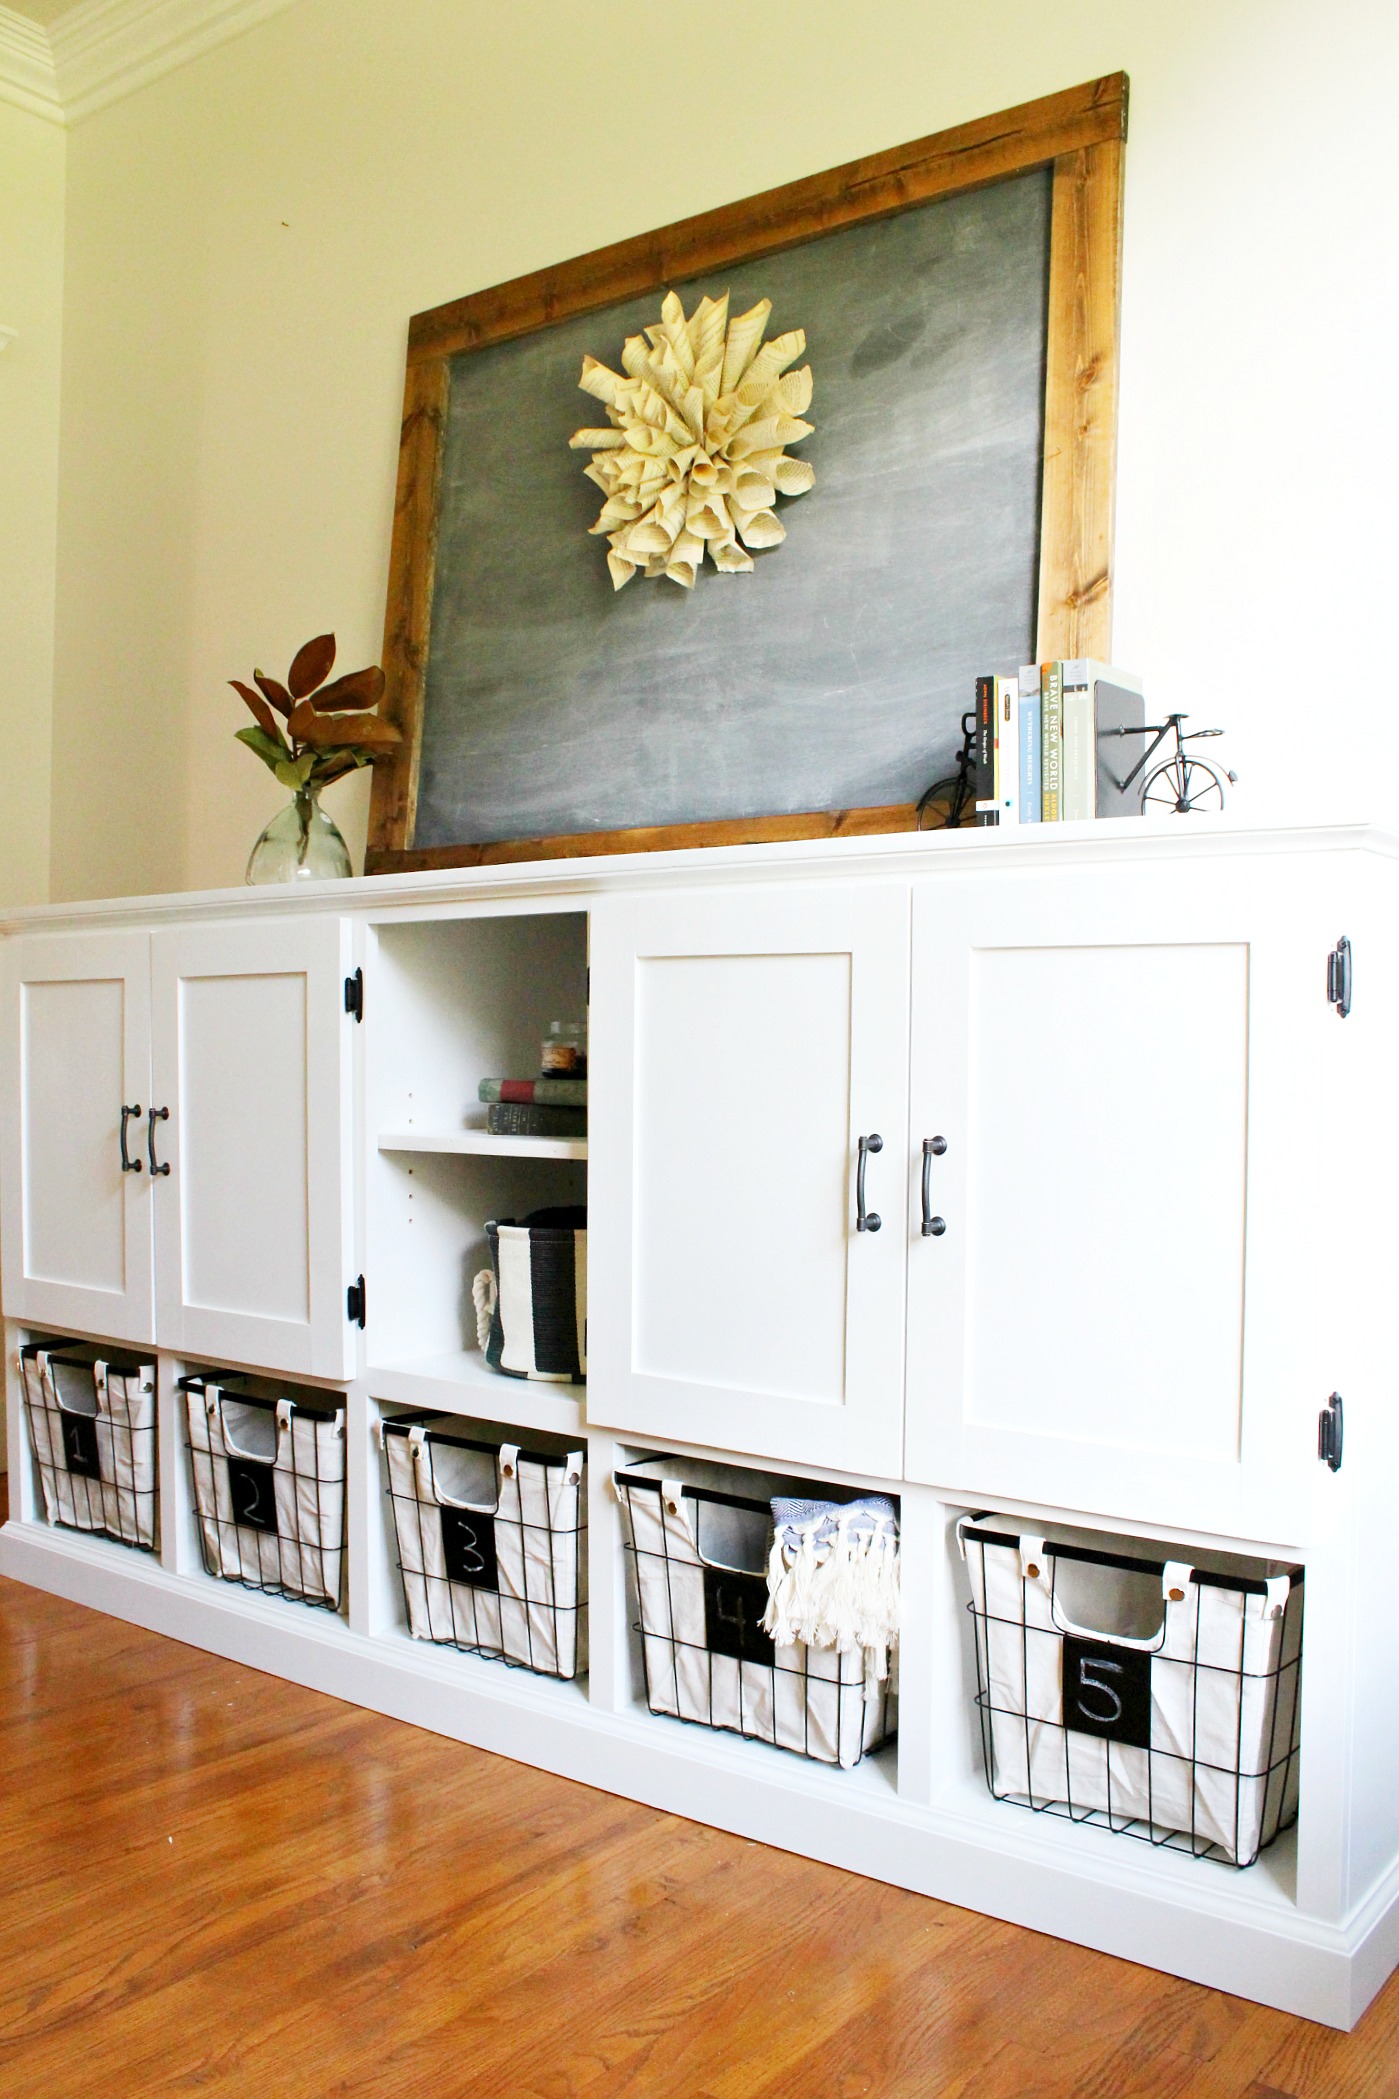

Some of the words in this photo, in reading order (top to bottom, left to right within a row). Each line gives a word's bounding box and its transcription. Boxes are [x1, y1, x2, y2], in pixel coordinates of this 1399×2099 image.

[1049, 674, 1058, 710] BRAVE
[1049, 715, 1058, 743] NEW
[1049, 748, 1058, 790] WORLD
[69, 1426, 89, 1463] 1
[240, 1473, 266, 1523] 2
[457, 1520, 485, 1573] 3
[716, 1585, 747, 1648] 4
[1077, 1657, 1125, 1723] 5
